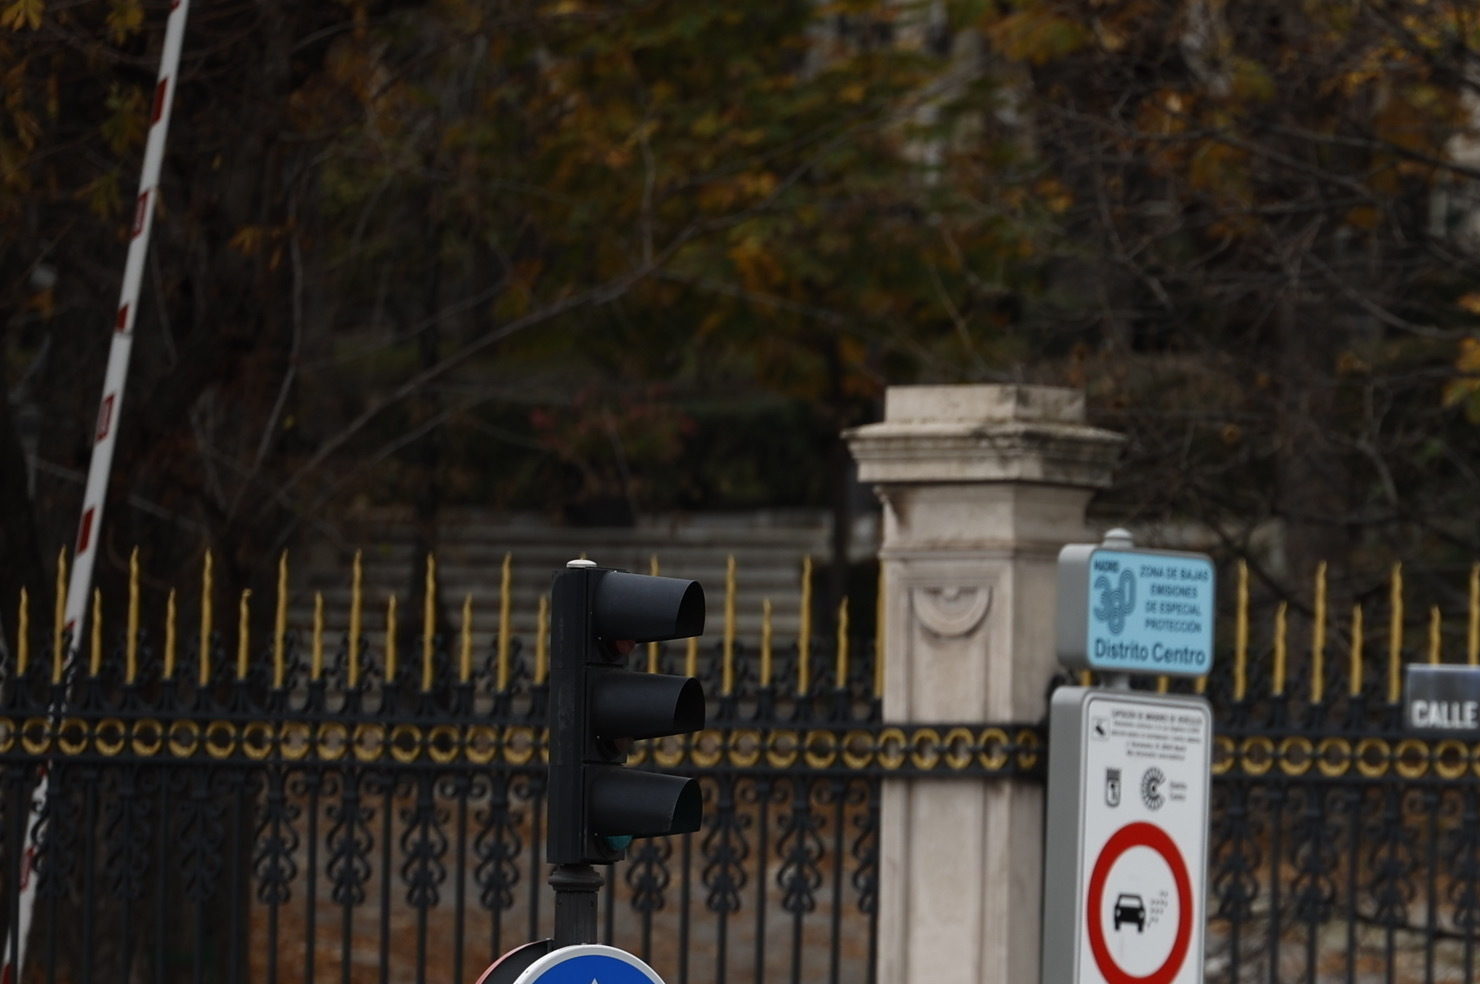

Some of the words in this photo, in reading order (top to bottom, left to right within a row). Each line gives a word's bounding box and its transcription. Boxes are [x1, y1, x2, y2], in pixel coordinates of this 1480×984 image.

[1140, 565, 1164, 578] ZONA
[1166, 567, 1178, 580] DE
[1180, 569, 1209, 582] BAJAS
[1150, 583, 1198, 599] EMISIONES
[1145, 601, 1157, 613] DE
[1159, 602, 1202, 616] ESPECIAL
[1094, 637, 1149, 661] Distrito
[1152, 641, 1206, 665] Centro
[1410, 700, 1478, 729] CALLE
